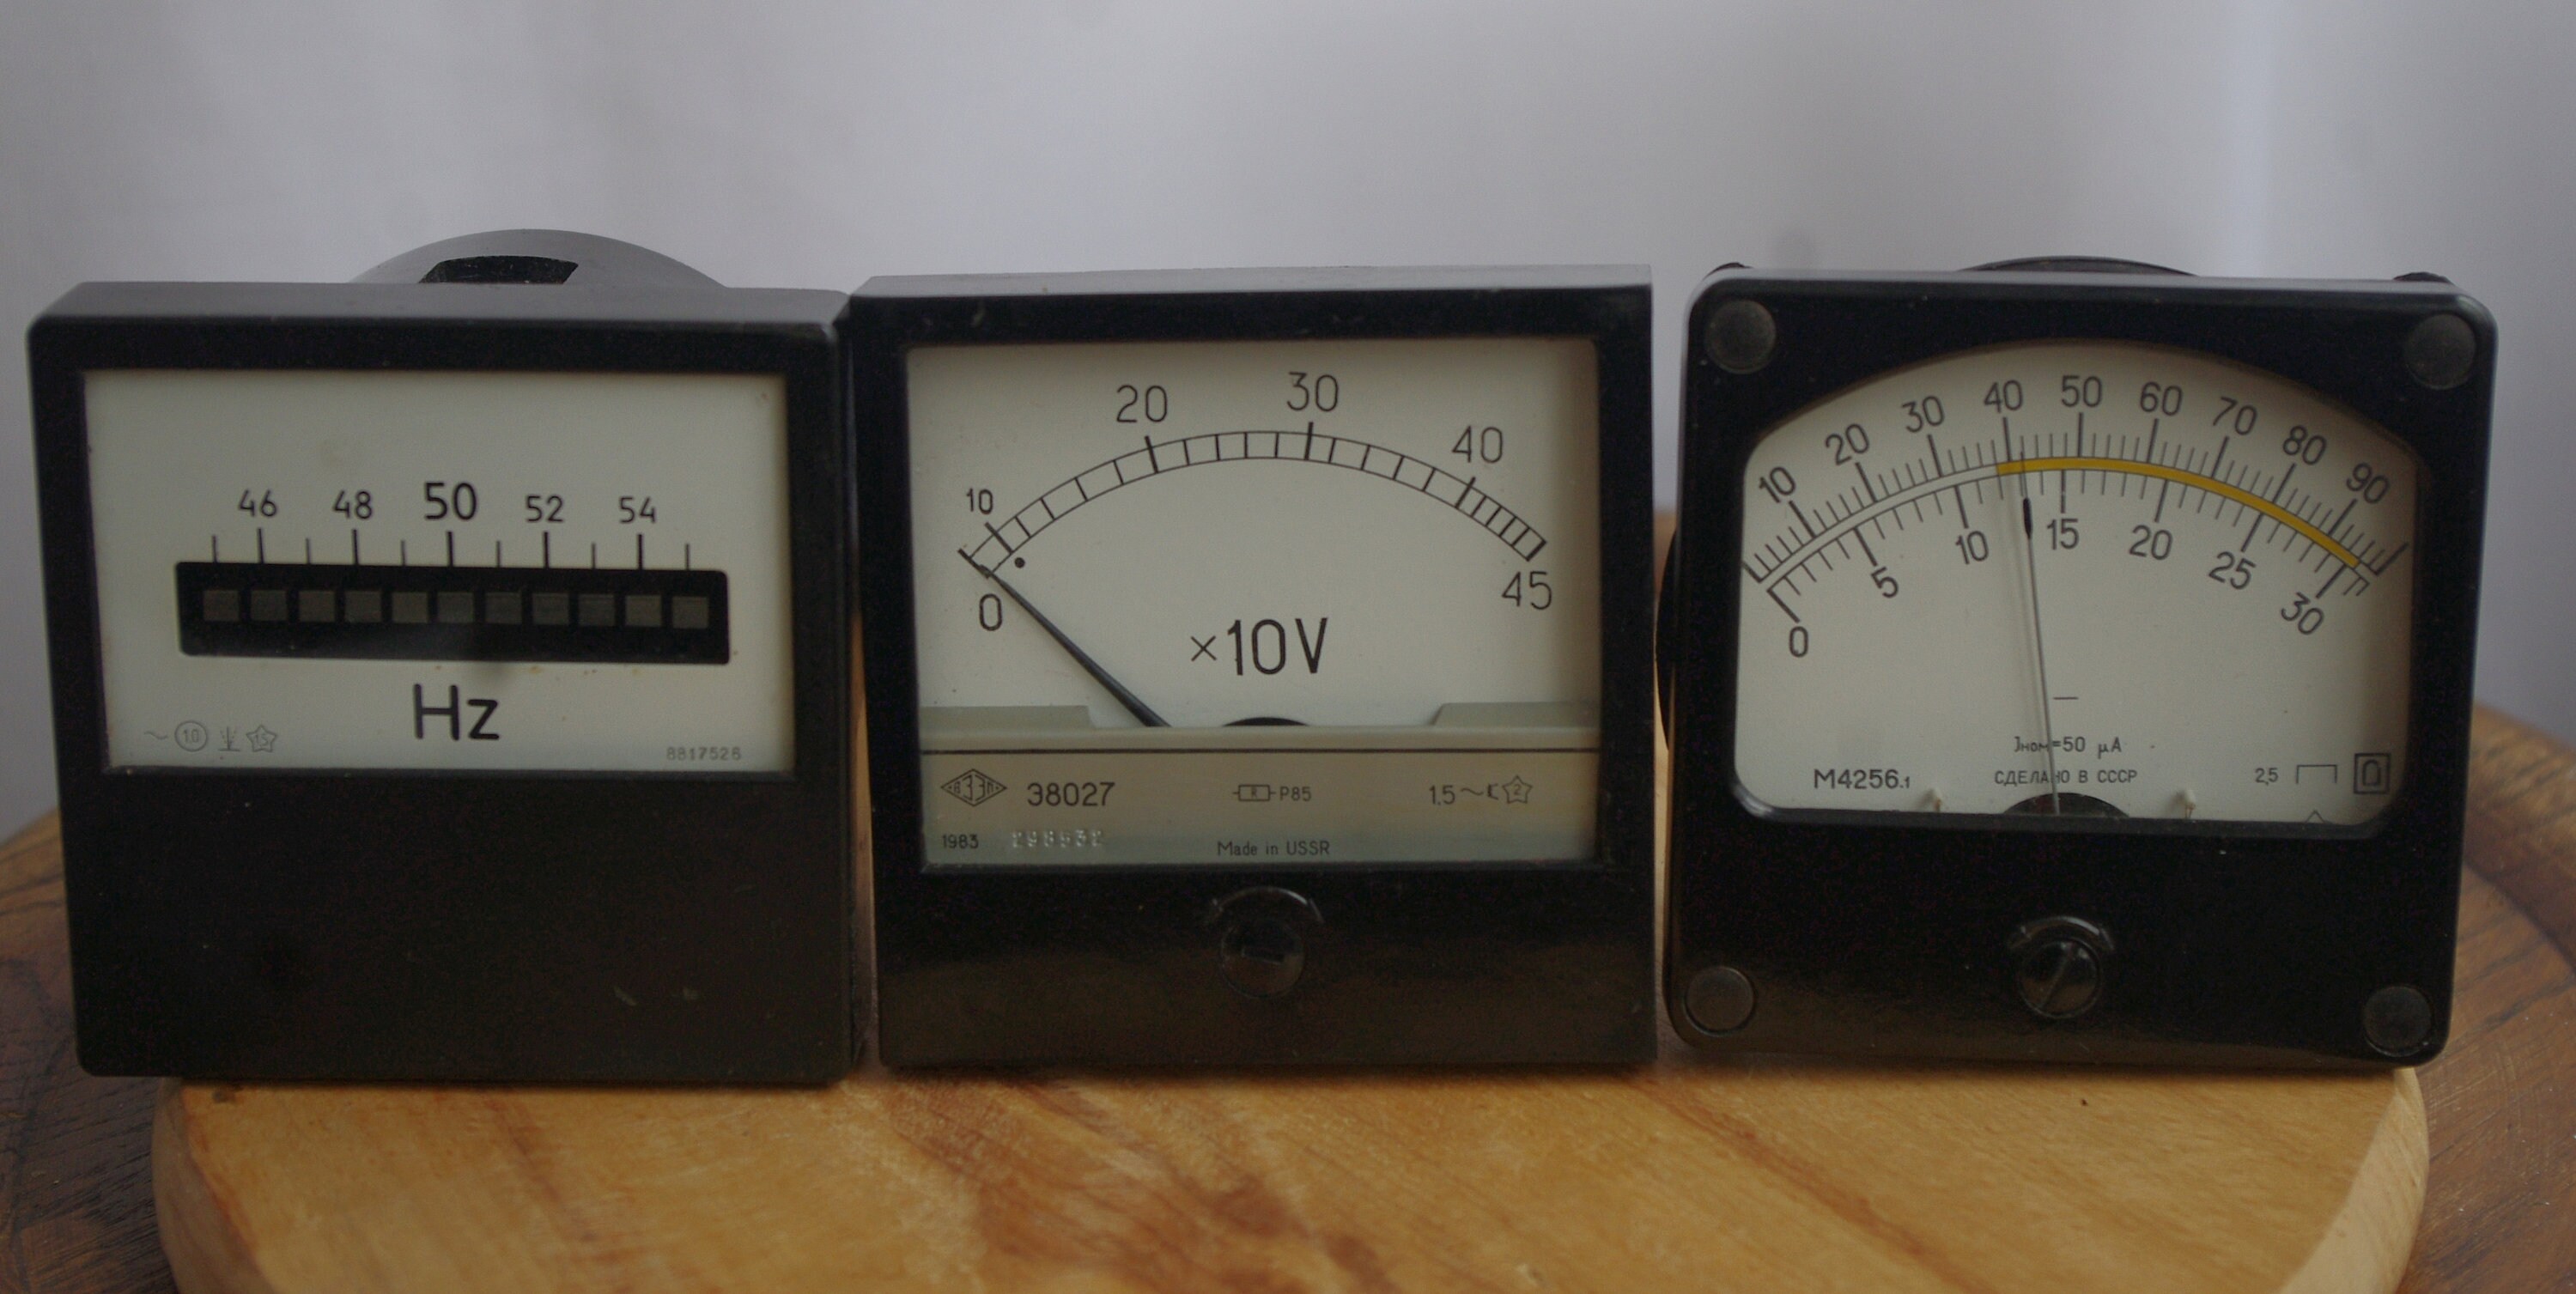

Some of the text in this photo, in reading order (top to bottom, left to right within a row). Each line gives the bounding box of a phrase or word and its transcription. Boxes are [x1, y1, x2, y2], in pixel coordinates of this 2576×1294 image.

[1116, 371, 1504, 465] 20 30 40
[1758, 374, 2390, 504] 10 20 30 40 50 60 70 80 90
[237, 481, 657, 525] 46 48 50 52 54
[966, 488, 994, 515] 10
[1501, 571, 1553, 611] 45
[1789, 518, 2324, 658] 0 5 10 15 20 25 30
[978, 593, 1004, 631] 0
[413, 683, 501, 742] Hz
[942, 833, 980, 850] 1983
[1217, 841, 1330, 857] Made in USSR
